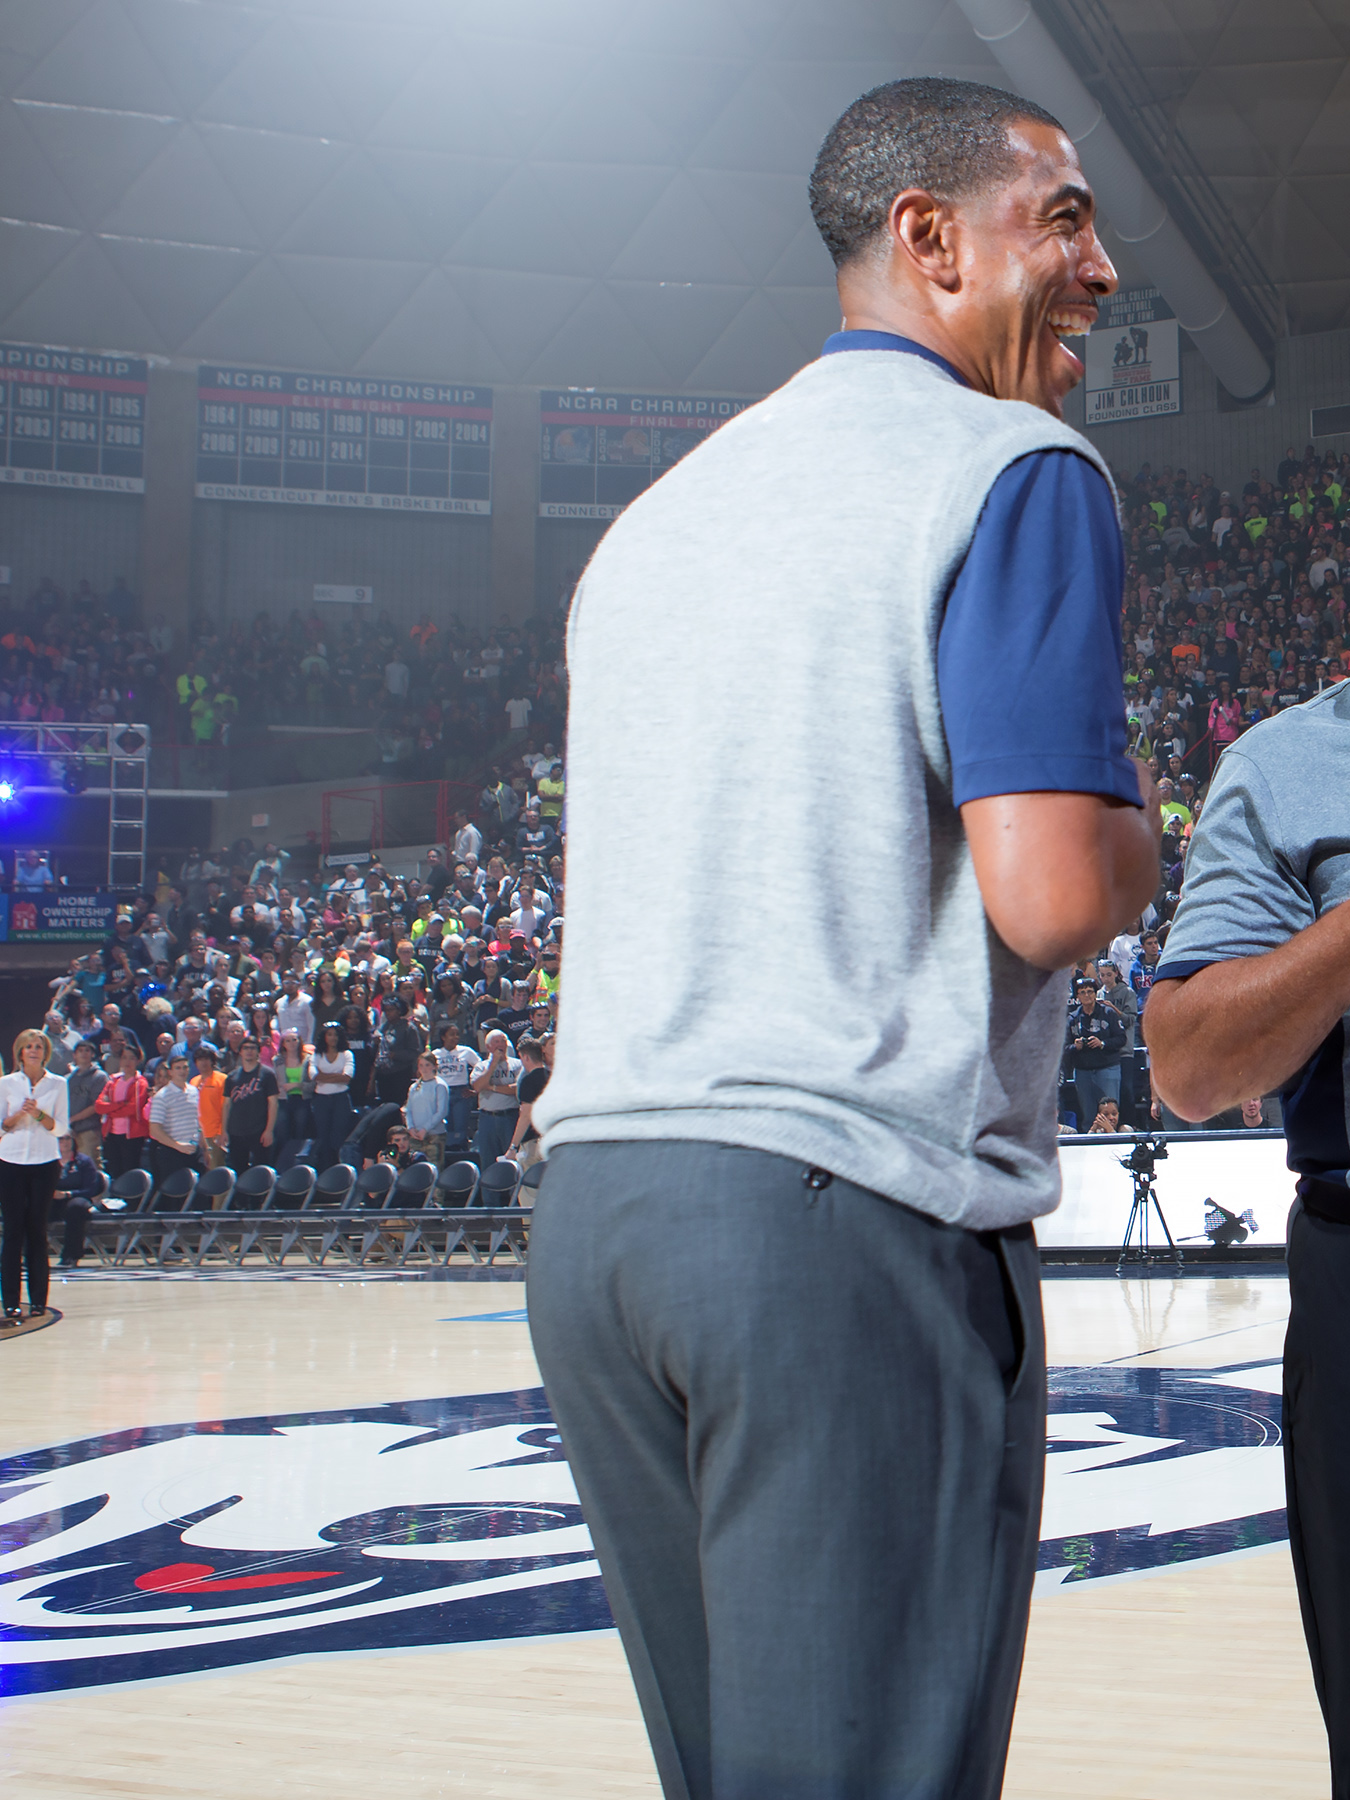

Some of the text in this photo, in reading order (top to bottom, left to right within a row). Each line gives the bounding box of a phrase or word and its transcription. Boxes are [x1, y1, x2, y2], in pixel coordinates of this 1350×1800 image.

[0, 350, 130, 376] PIONSHIP
[217, 371, 476, 403] NCAA CHAMPIONSHIP
[292, 395, 343, 409] ELITE
[558, 396, 618, 411] NCAA
[1095, 384, 1170, 410] JIM CALHOUN
[1088, 401, 1177, 422] FOUNDING CLASS
[630, 415, 677, 428] FINAL
[415, 420, 447, 440] 2002
[456, 422, 487, 442] 2004
[24, 471, 136, 490] BASKETBALL
[204, 486, 317, 503] CONNECTICUT
[381, 497, 482, 513] BASKETBALL
[355, 588, 366, 602] 9
[58, 896, 97, 906] HOME
[42, 907, 112, 917] OWNERSHIP
[48, 918, 105, 928] MATTERS
